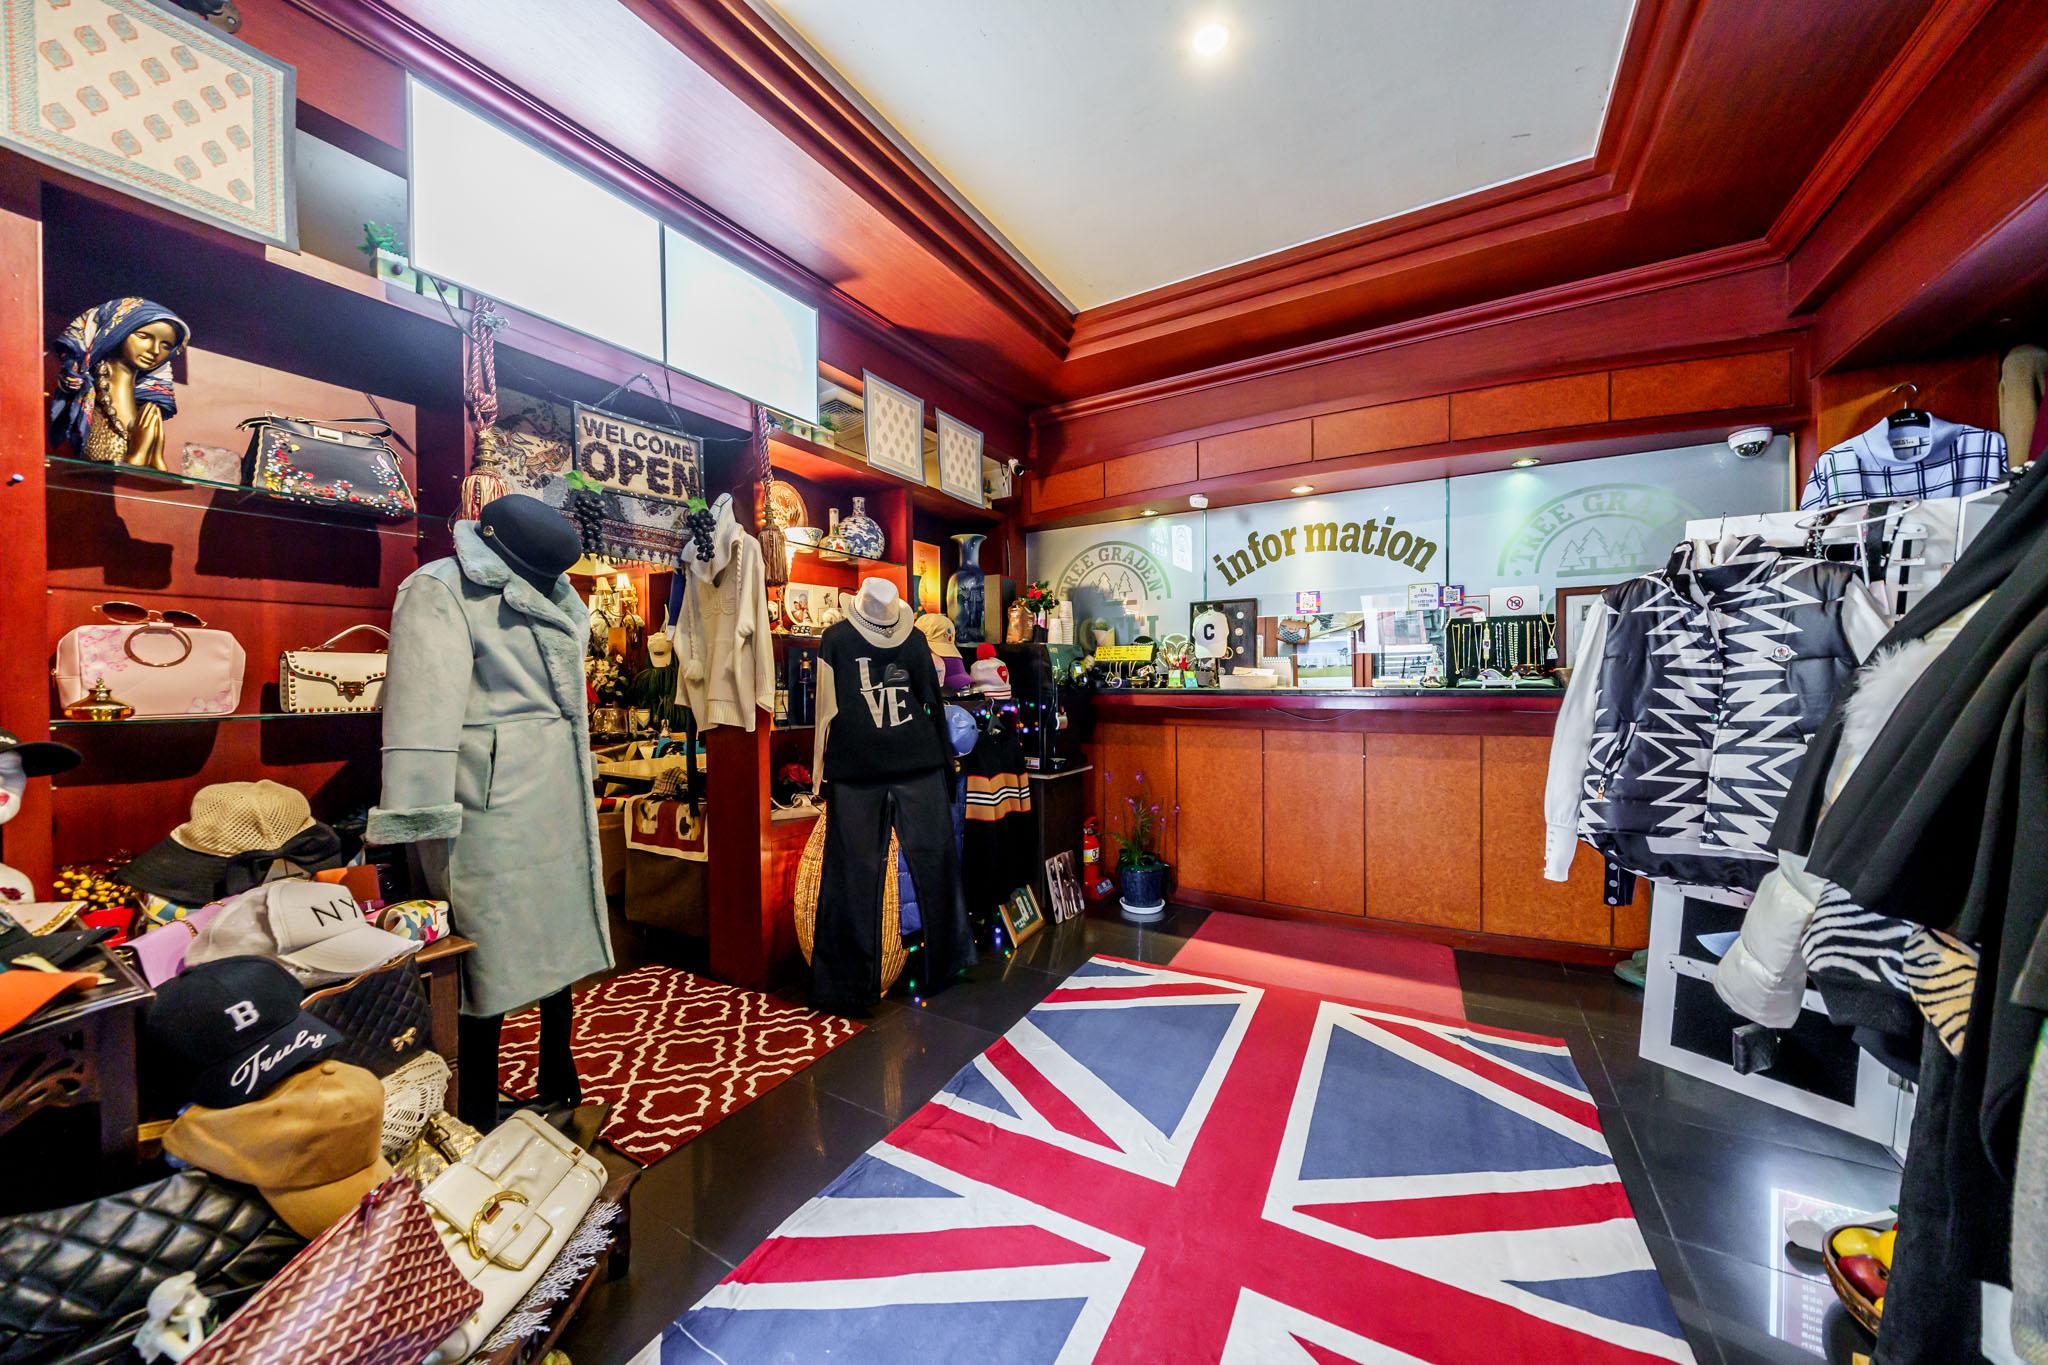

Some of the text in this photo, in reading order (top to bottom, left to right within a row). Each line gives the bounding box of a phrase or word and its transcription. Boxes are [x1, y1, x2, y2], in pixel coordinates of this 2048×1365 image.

[582, 415, 694, 463] WELCOME
[581, 440, 699, 499] OPEN
[1509, 503, 1575, 565] TREE
[1059, 546, 1164, 597] TREE GRADEN
[1203, 623, 1215, 640] C
[310, 899, 358, 927] NY
[224, 1001, 261, 1032] B
[230, 1030, 327, 1095] Truly
